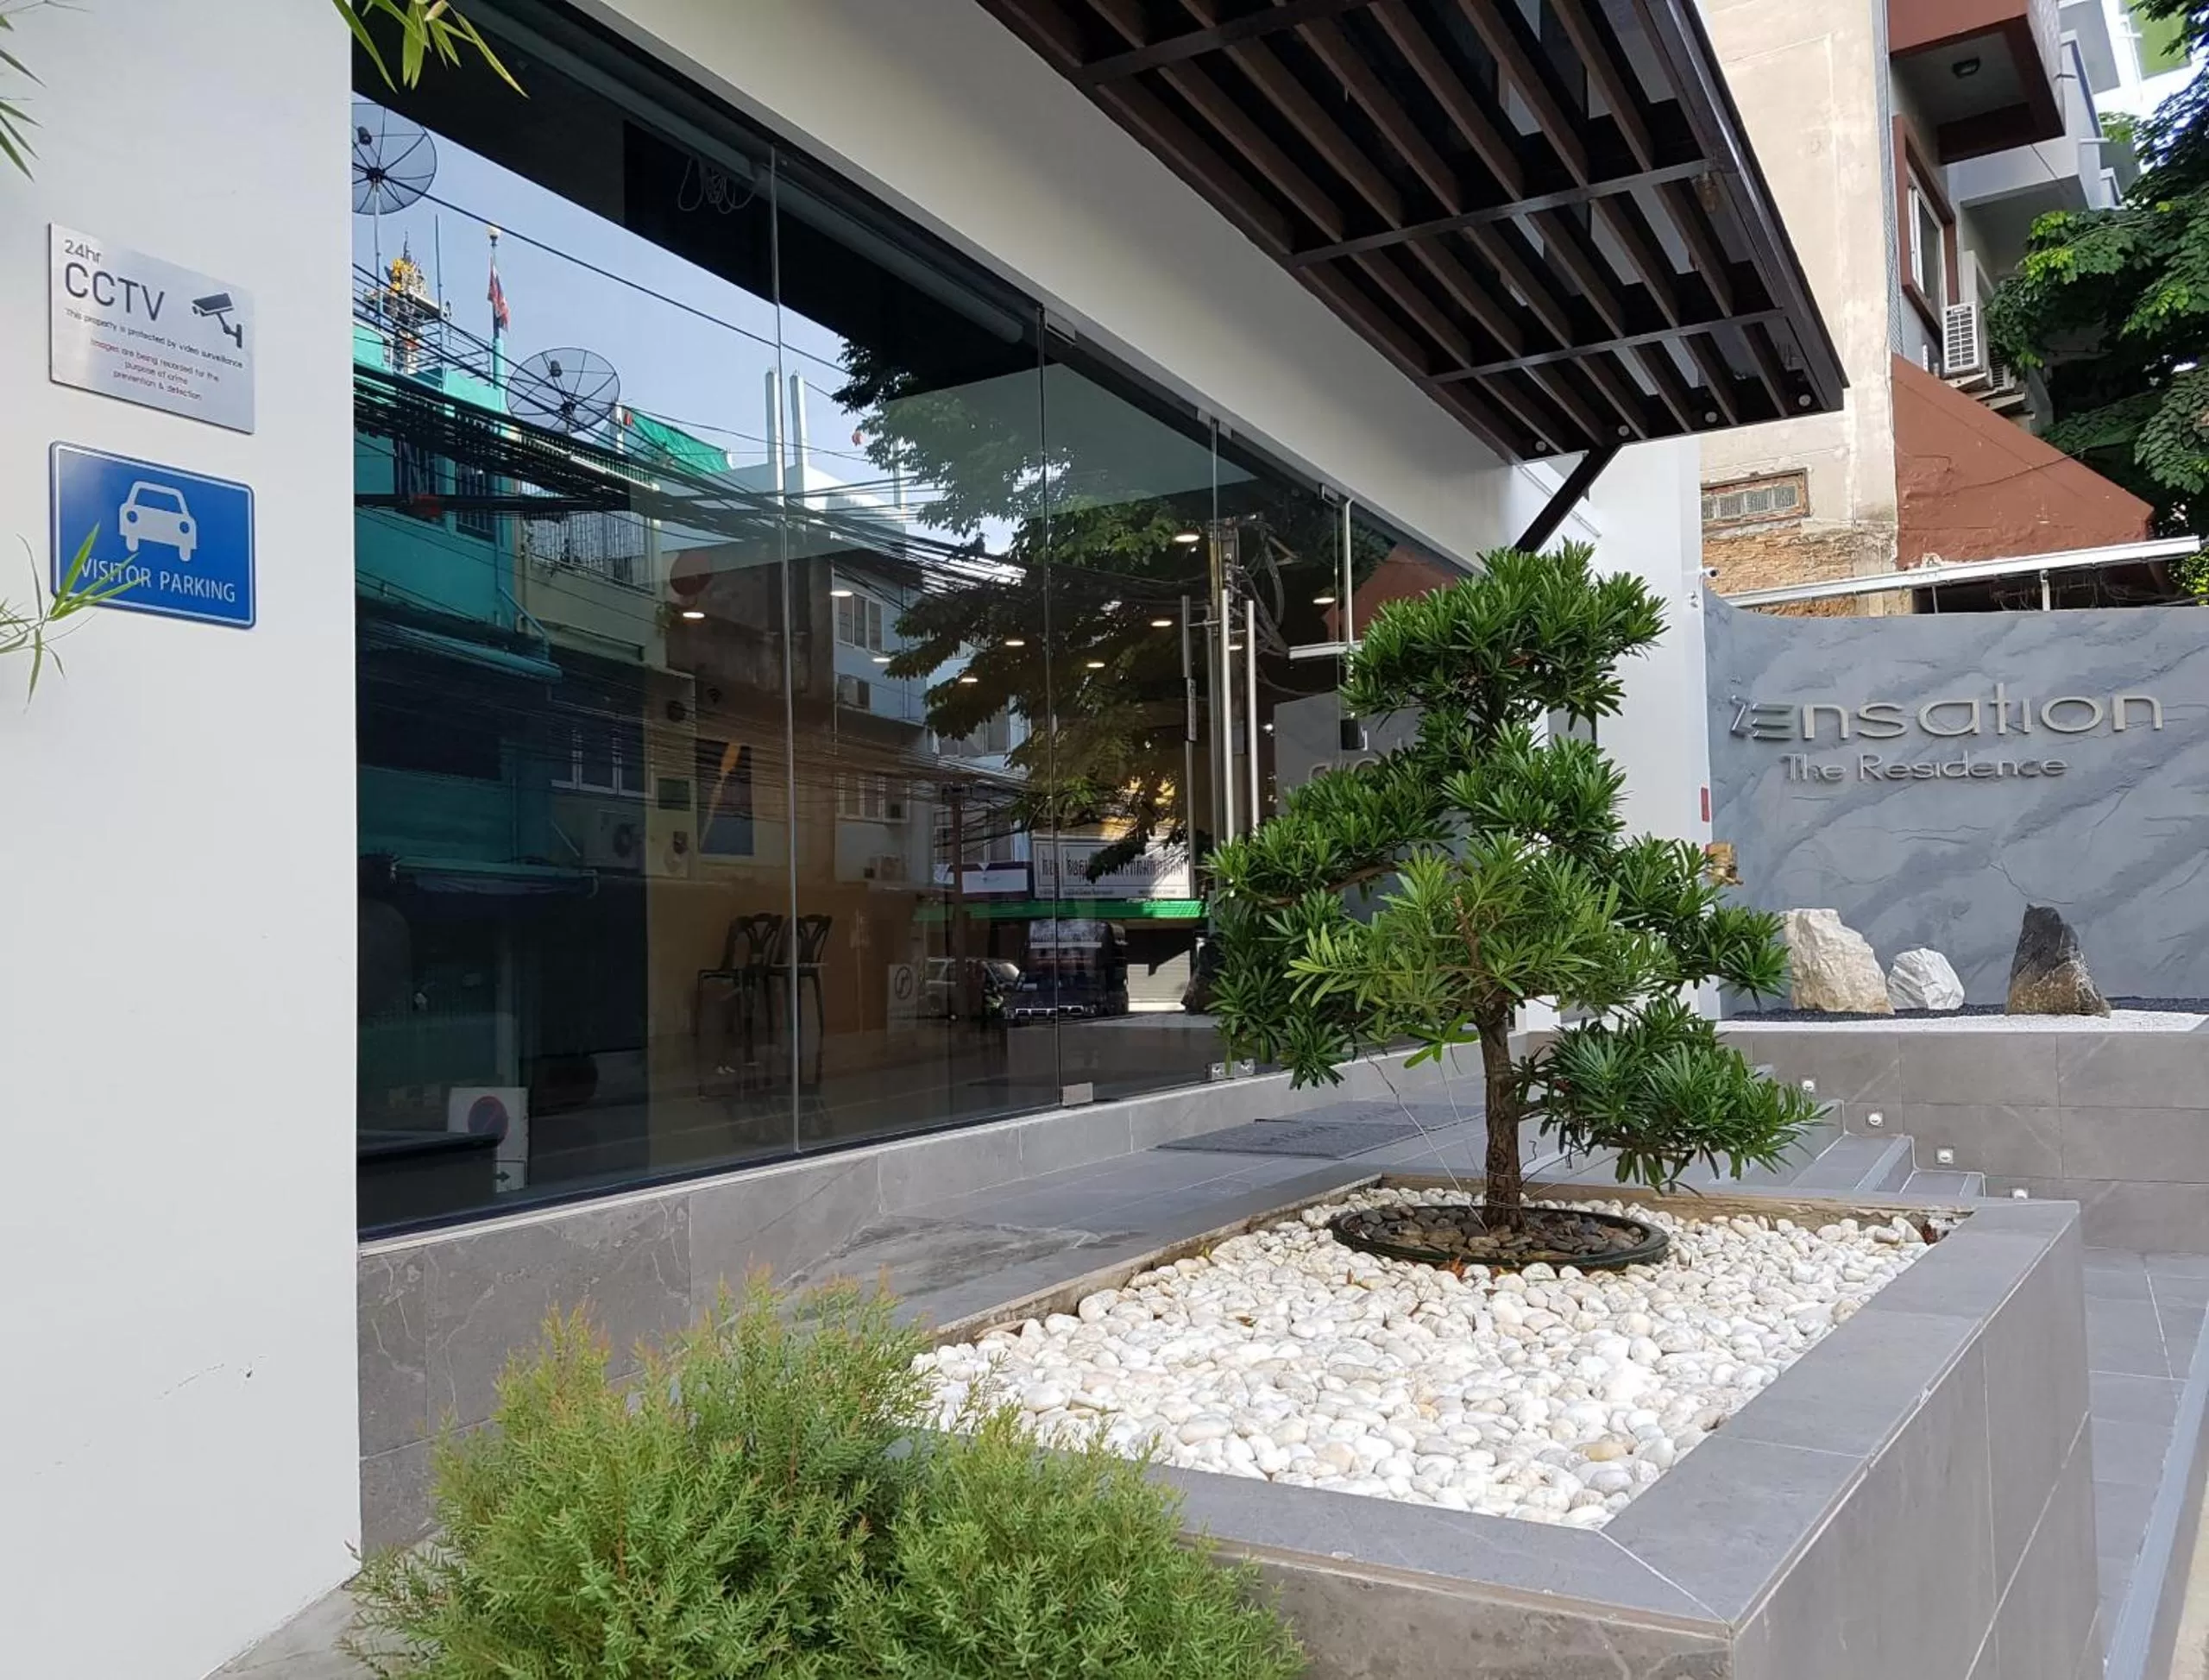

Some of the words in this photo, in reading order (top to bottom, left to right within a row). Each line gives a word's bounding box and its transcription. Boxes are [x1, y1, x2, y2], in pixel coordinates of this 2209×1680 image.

[64, 239, 102, 263] 24hr
[65, 261, 165, 322] CCTV
[84, 315, 117, 332] property
[127, 328, 166, 345] protected
[167, 337, 177, 349] by
[179, 344, 199, 356] video
[121, 348, 135, 357] are
[135, 352, 159, 366] being
[160, 358, 194, 374] recorded
[124, 362, 156, 376] purpose
[113, 370, 156, 387] prevention
[80, 557, 152, 588] VISITOR
[159, 569, 236, 602] PARKING
[1781, 752, 1847, 782] The
[1859, 751, 2068, 782] Residence
